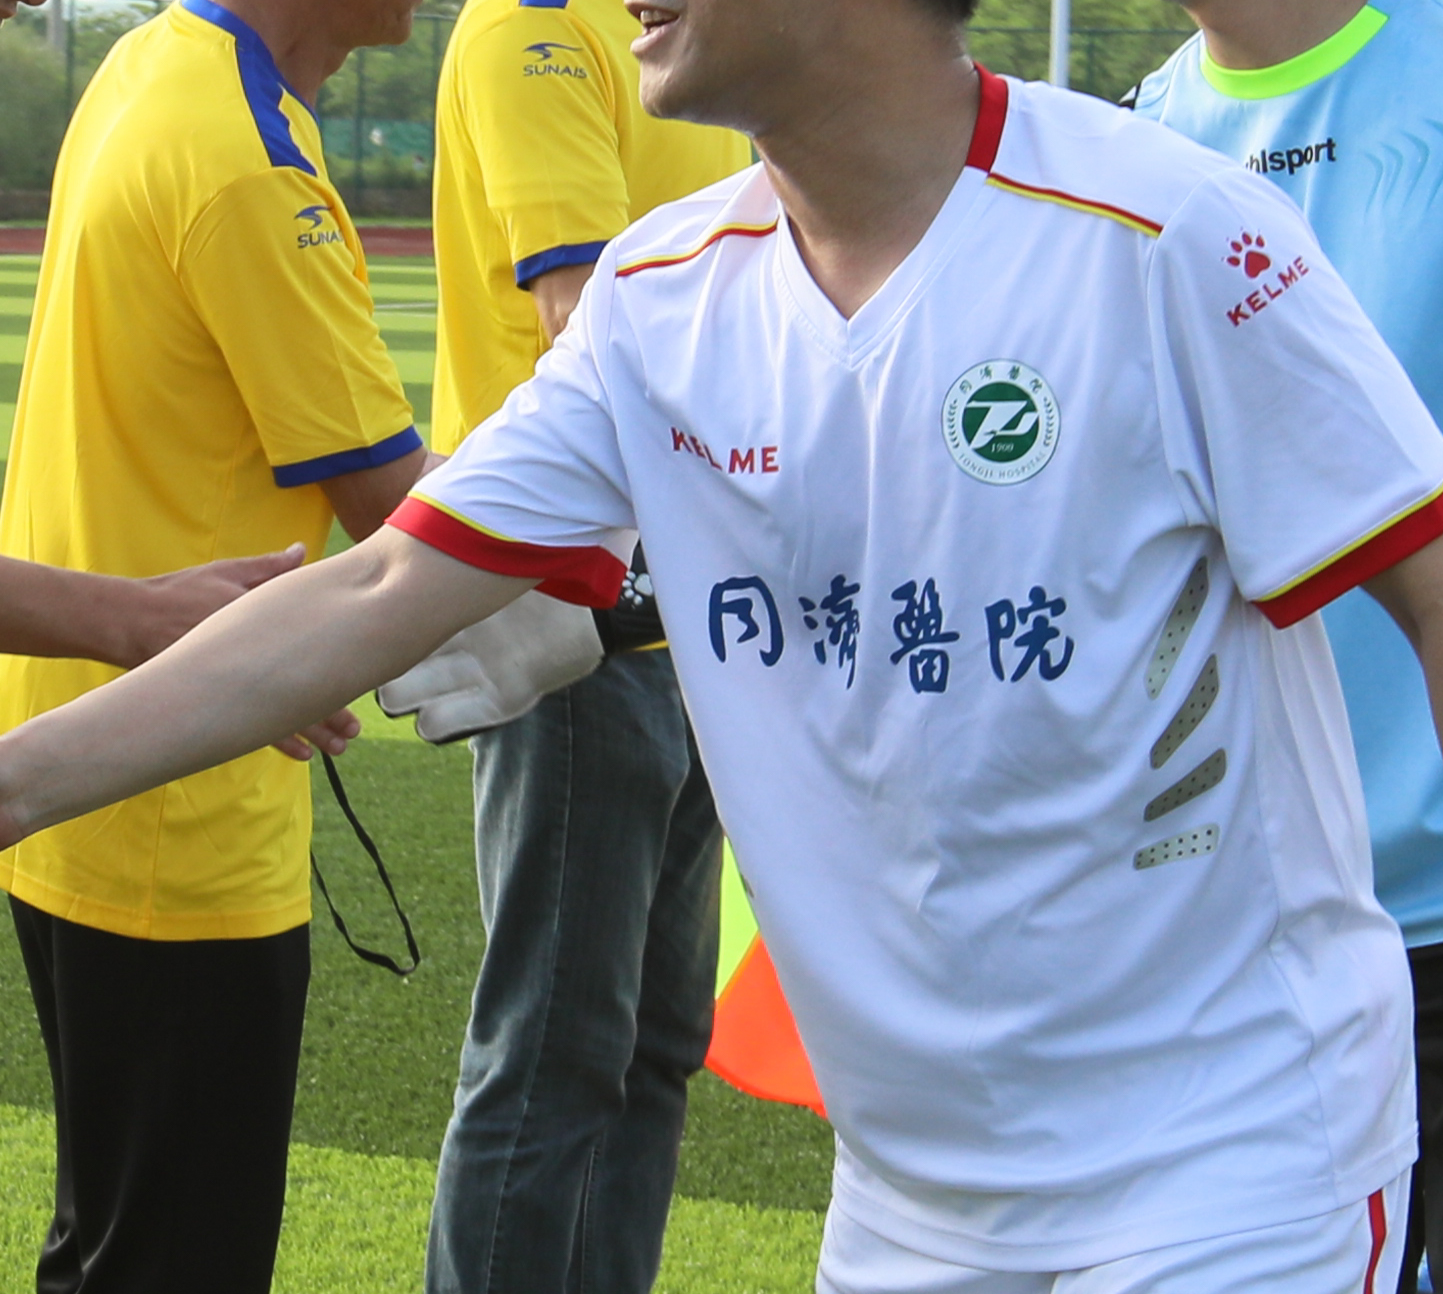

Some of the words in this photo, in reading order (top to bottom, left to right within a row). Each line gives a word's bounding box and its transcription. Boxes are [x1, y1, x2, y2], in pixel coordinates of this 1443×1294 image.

[522, 64, 588, 80] SUNAIS
[1245, 137, 1337, 176] hlsport
[1225, 255, 1310, 328] KELME
[669, 425, 781, 475] KELME
[707, 573, 1076, 695] 同濟醫院
